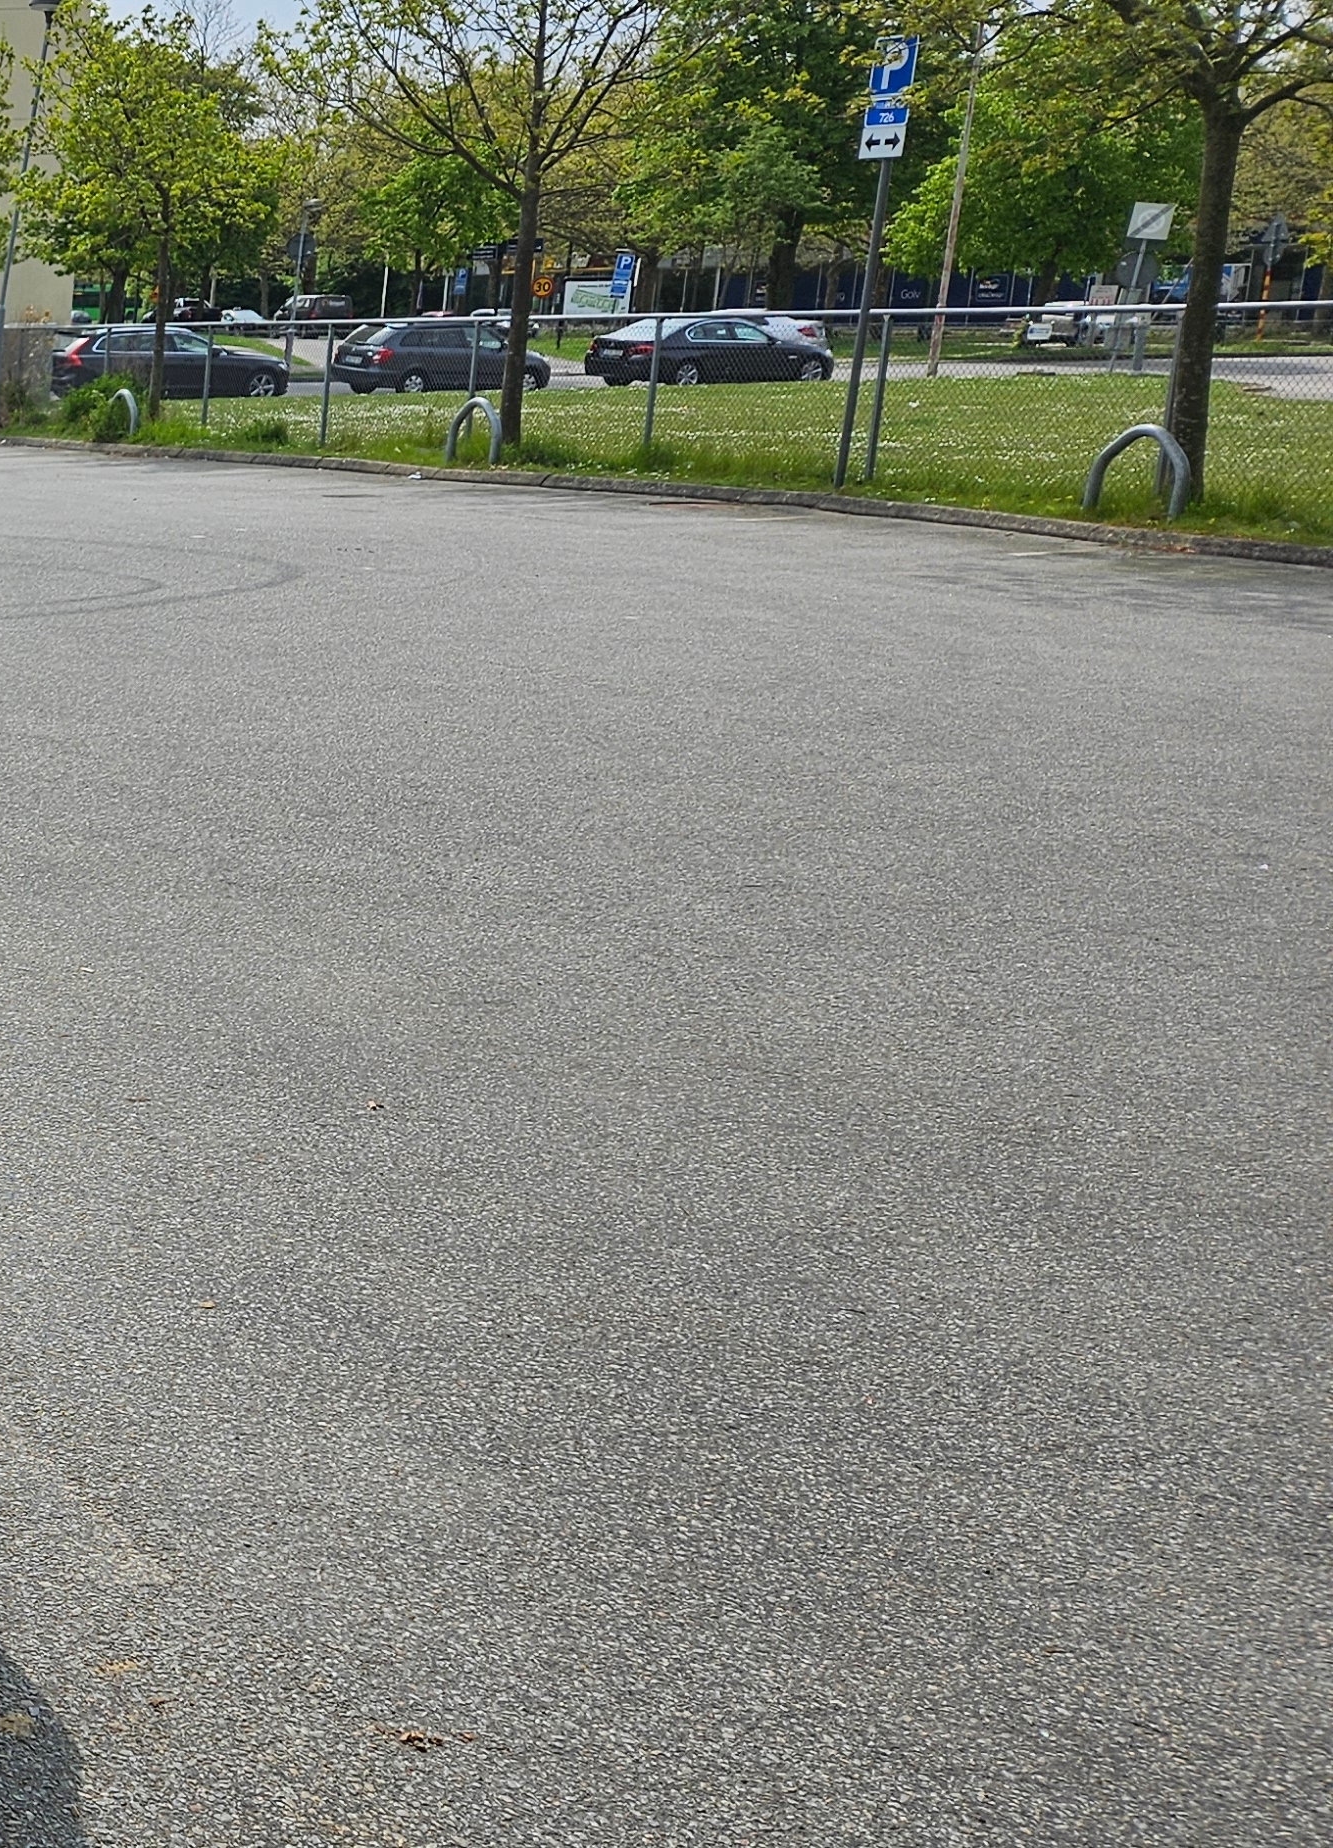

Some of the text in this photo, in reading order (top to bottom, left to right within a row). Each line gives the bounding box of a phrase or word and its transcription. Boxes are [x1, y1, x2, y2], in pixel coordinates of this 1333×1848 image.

[881, 42, 909, 90] P
[879, 112, 895, 123] 726
[620, 256, 632, 269] P
[458, 268, 467, 278] P
[535, 281, 551, 292] 30
